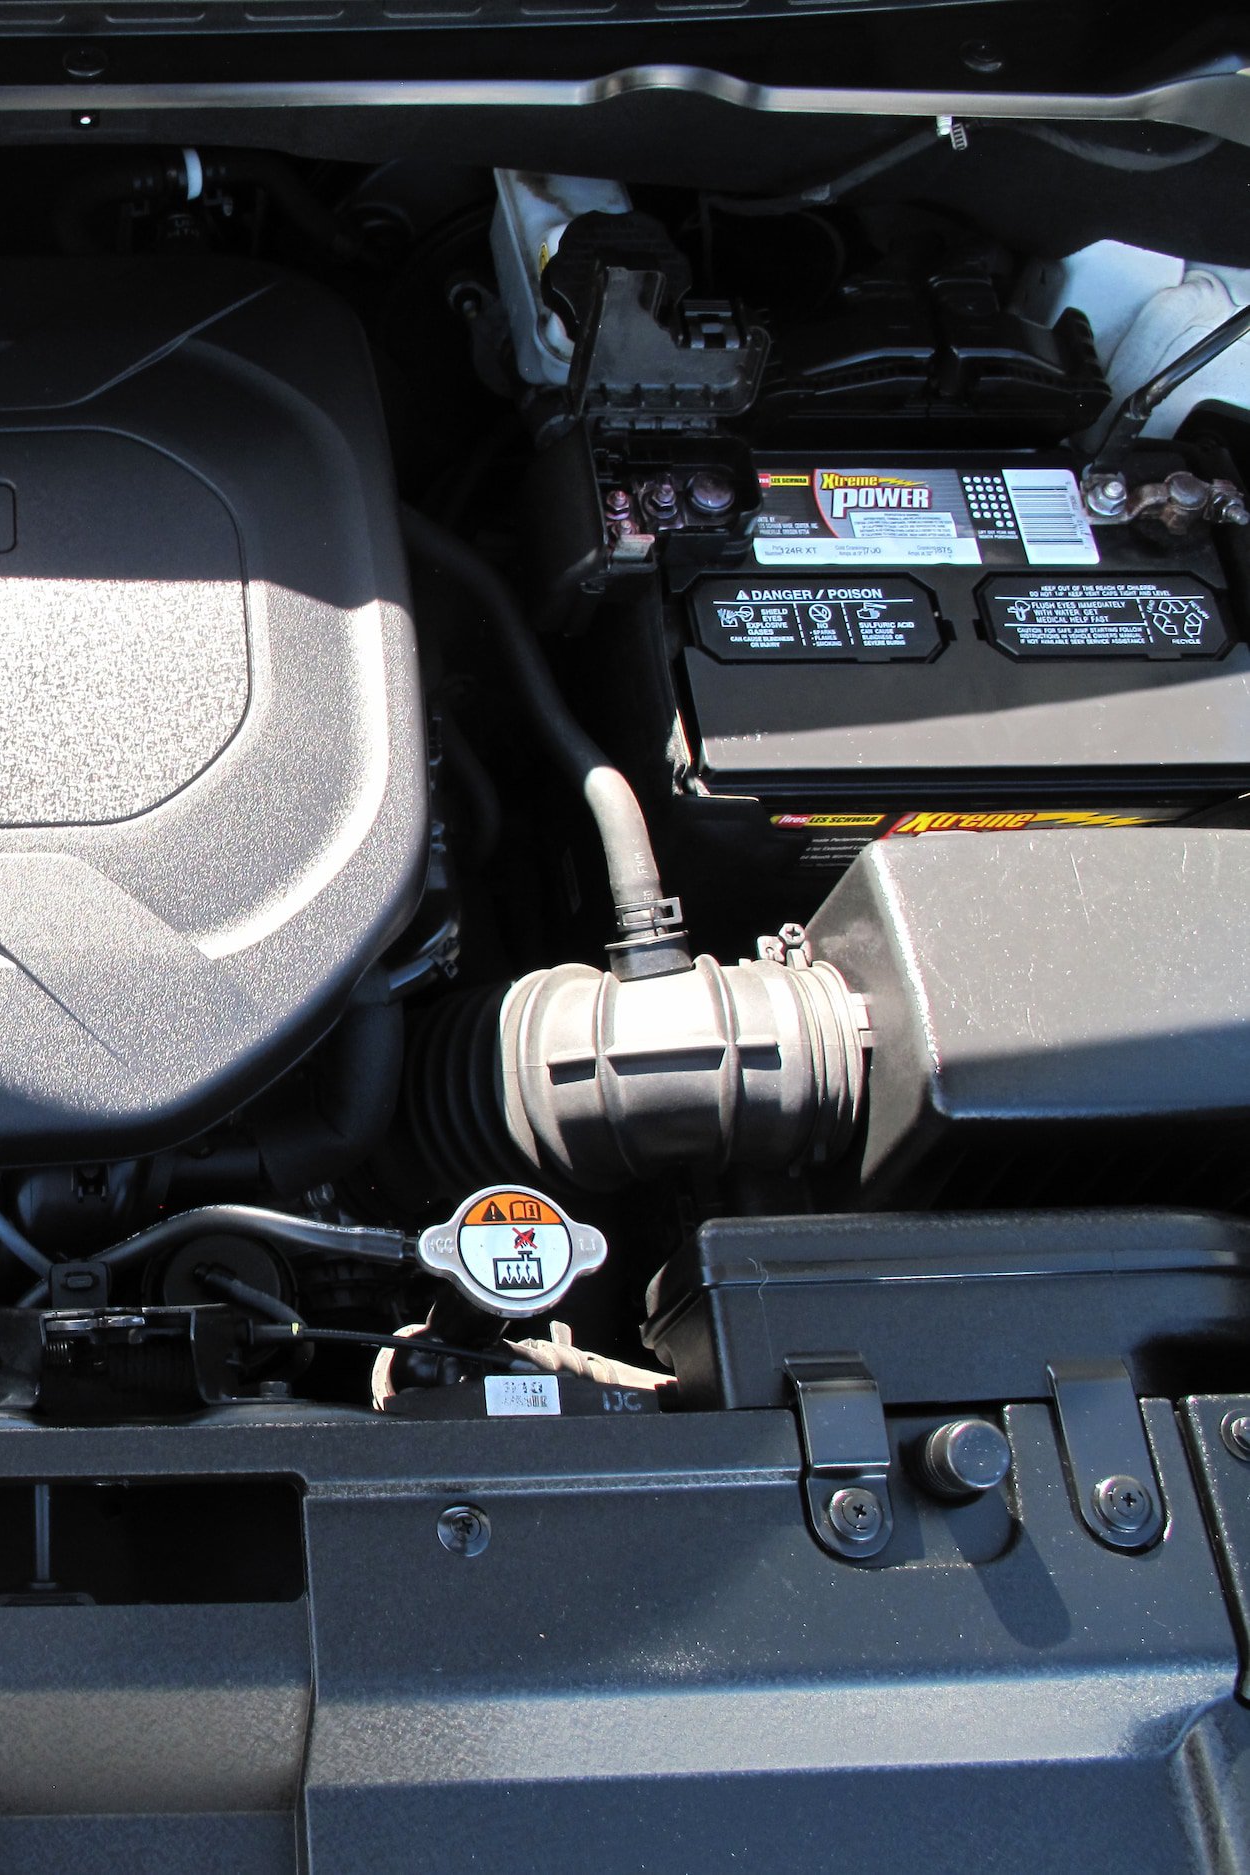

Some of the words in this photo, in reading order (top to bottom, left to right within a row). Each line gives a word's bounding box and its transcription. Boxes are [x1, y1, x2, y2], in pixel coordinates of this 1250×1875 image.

[821, 473, 879, 489] Xtreme
[832, 488, 930, 518] POWER
[751, 589, 813, 601] DANGER
[828, 589, 883, 601] POISON
[1031, 601, 1055, 610] FLUSH
[1057, 601, 1076, 610] EYES
[1077, 601, 1126, 610] IMMEDIATELY
[1033, 609, 1052, 617] WITH
[1083, 609, 1099, 617] GET
[1036, 615, 1068, 623] MEDICAL
[1069, 615, 1089, 623] HELP
[1090, 615, 1110, 623] FAST
[858, 621, 896, 629] SULFURIC
[897, 621, 915, 629] ACID
[808, 815, 828, 825] LES
[828, 815, 880, 825] SCHWAB
[897, 812, 1036, 832] Xtreme
